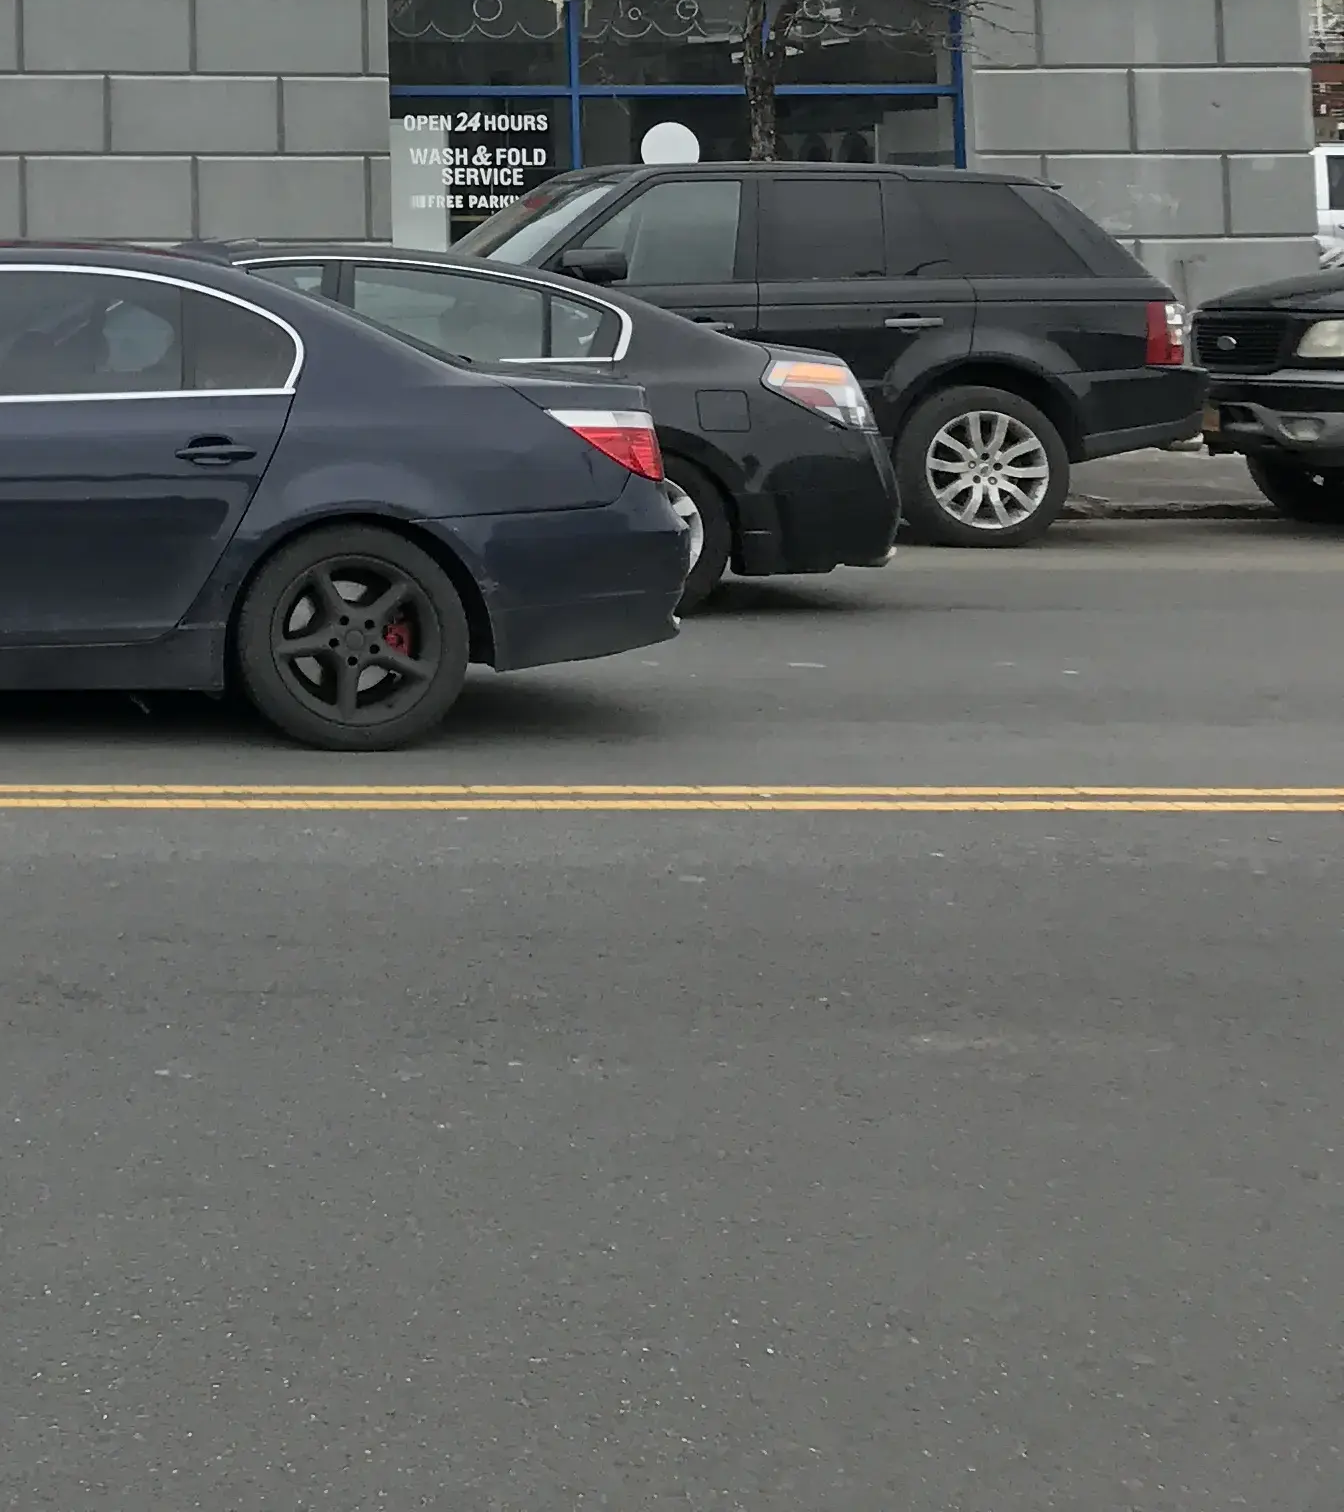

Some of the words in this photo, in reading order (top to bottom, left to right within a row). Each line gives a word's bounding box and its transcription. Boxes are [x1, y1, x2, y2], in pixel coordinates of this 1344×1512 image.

[403, 114, 452, 131] OPEN
[454, 111, 482, 132] 24
[484, 114, 548, 131] HOURS
[409, 147, 469, 166] WASH
[472, 145, 492, 166] &
[495, 147, 547, 166] FOLD
[441, 167, 525, 186] SERVICE
[427, 194, 464, 208] FREE
